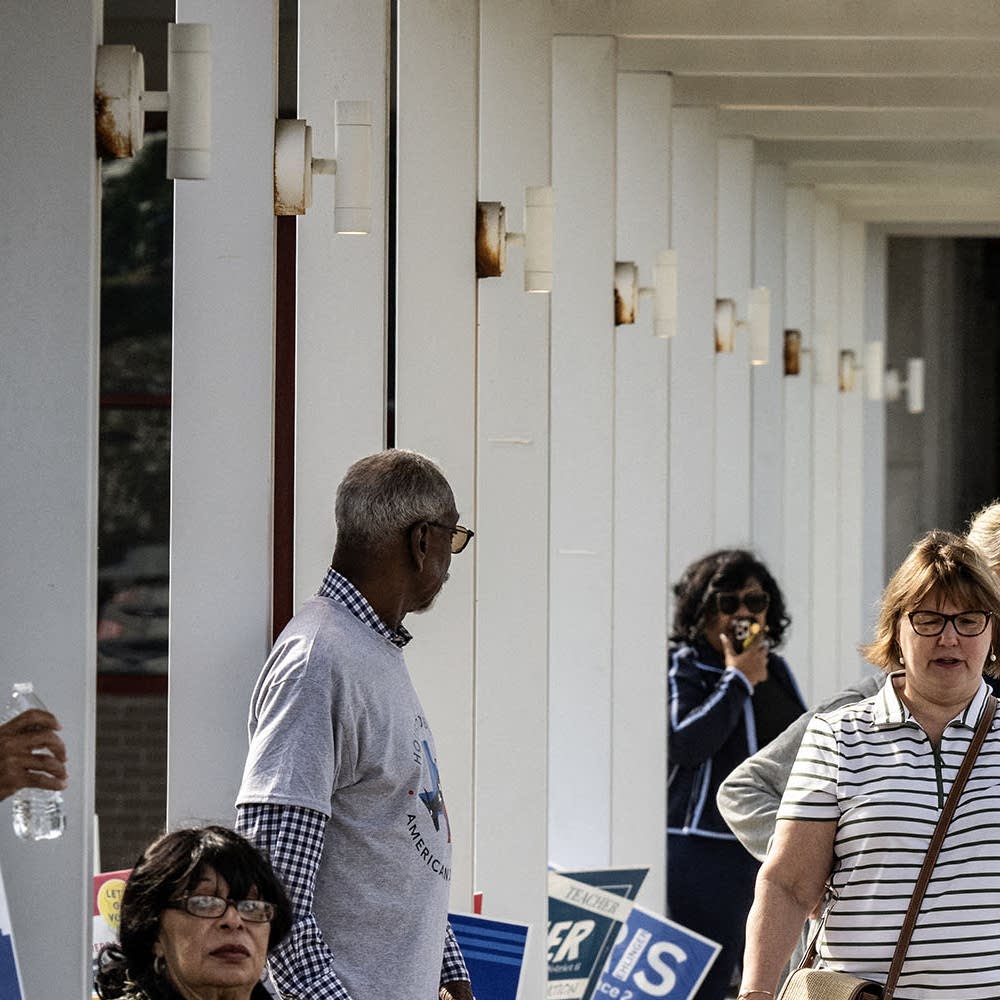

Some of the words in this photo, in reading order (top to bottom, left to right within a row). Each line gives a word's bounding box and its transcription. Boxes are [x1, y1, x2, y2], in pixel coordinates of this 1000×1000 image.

[564, 885, 620, 914] TEACHER
[548, 920, 595, 962] ER
[599, 982, 620, 999] ce
